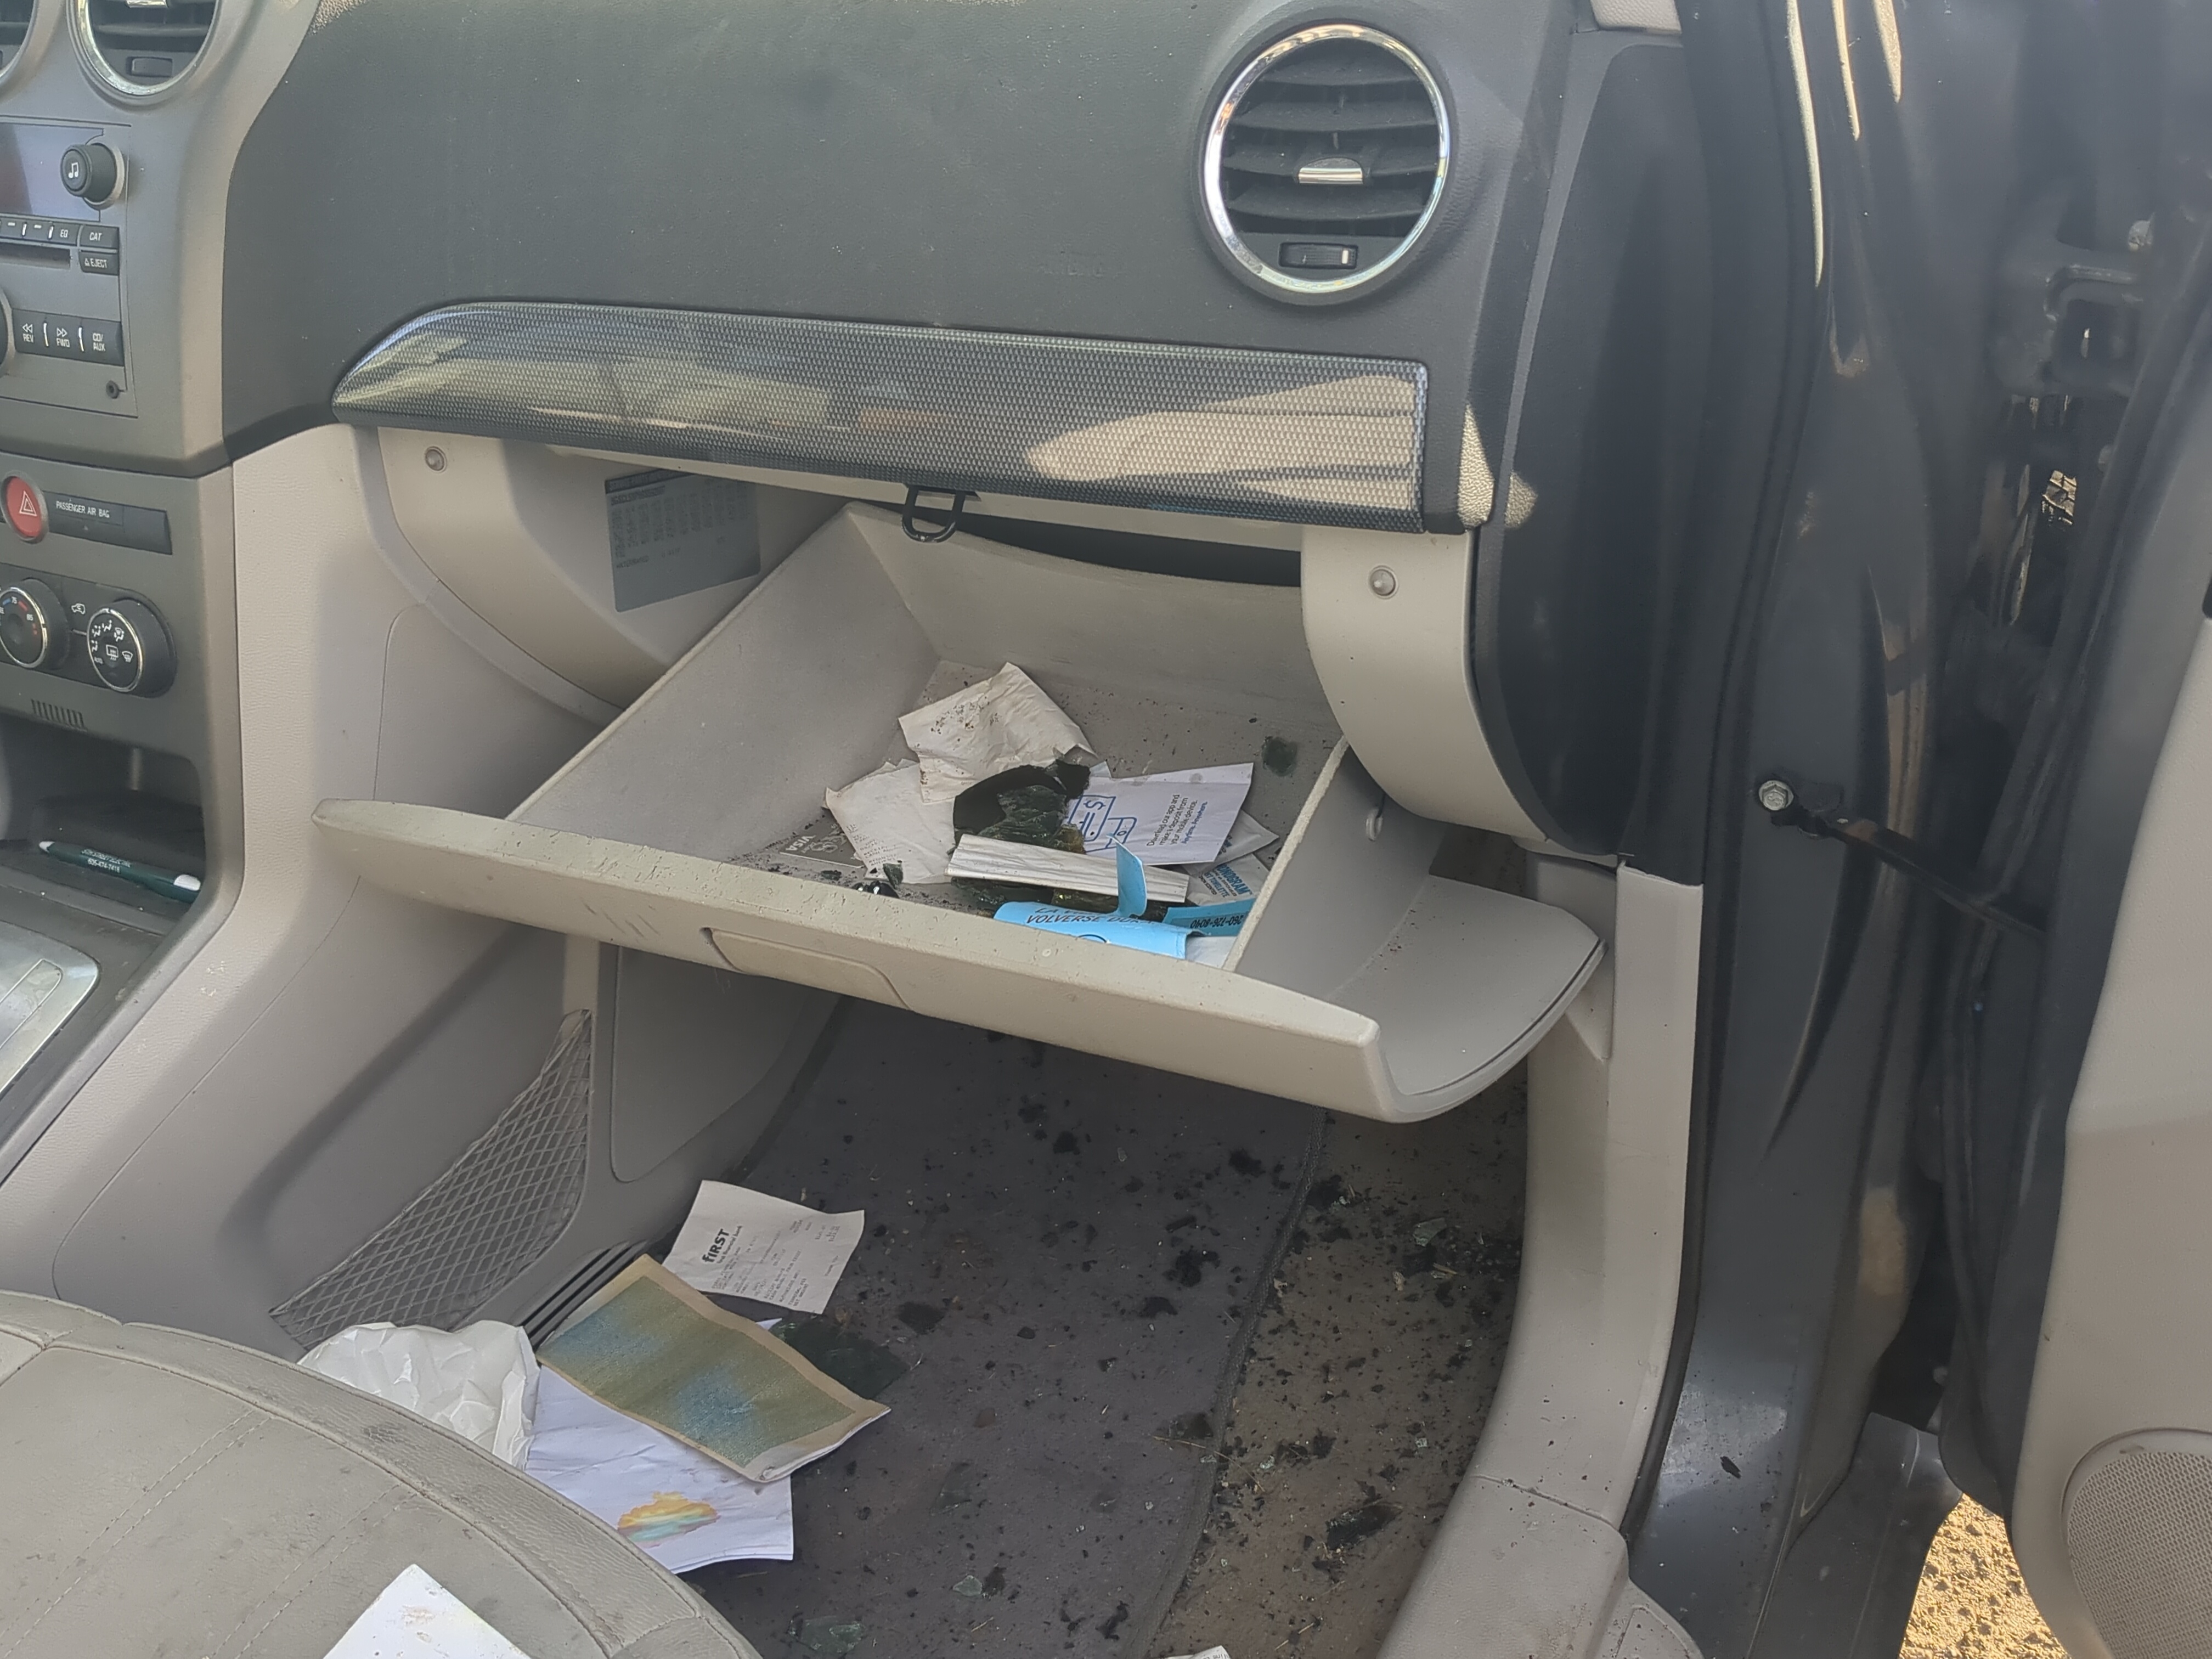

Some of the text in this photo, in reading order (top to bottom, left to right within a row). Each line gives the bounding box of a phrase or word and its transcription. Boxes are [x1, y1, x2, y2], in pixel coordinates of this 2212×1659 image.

[60, 229, 69, 238] EQ
[89, 232, 103, 241] CAT
[90, 258, 108, 268] EJECT
[22, 334, 34, 343] REV
[92, 332, 104, 342] CD/
[56, 337, 70, 348] FWD
[93, 342, 106, 352] AUX
[56, 500, 110, 518] PASSENGER AIR BAG
[1171, 794, 1180, 804] and
[1177, 798, 1188, 810] from
[786, 834, 816, 851] VISA
[1026, 915, 1104, 924] VOLVERSE
